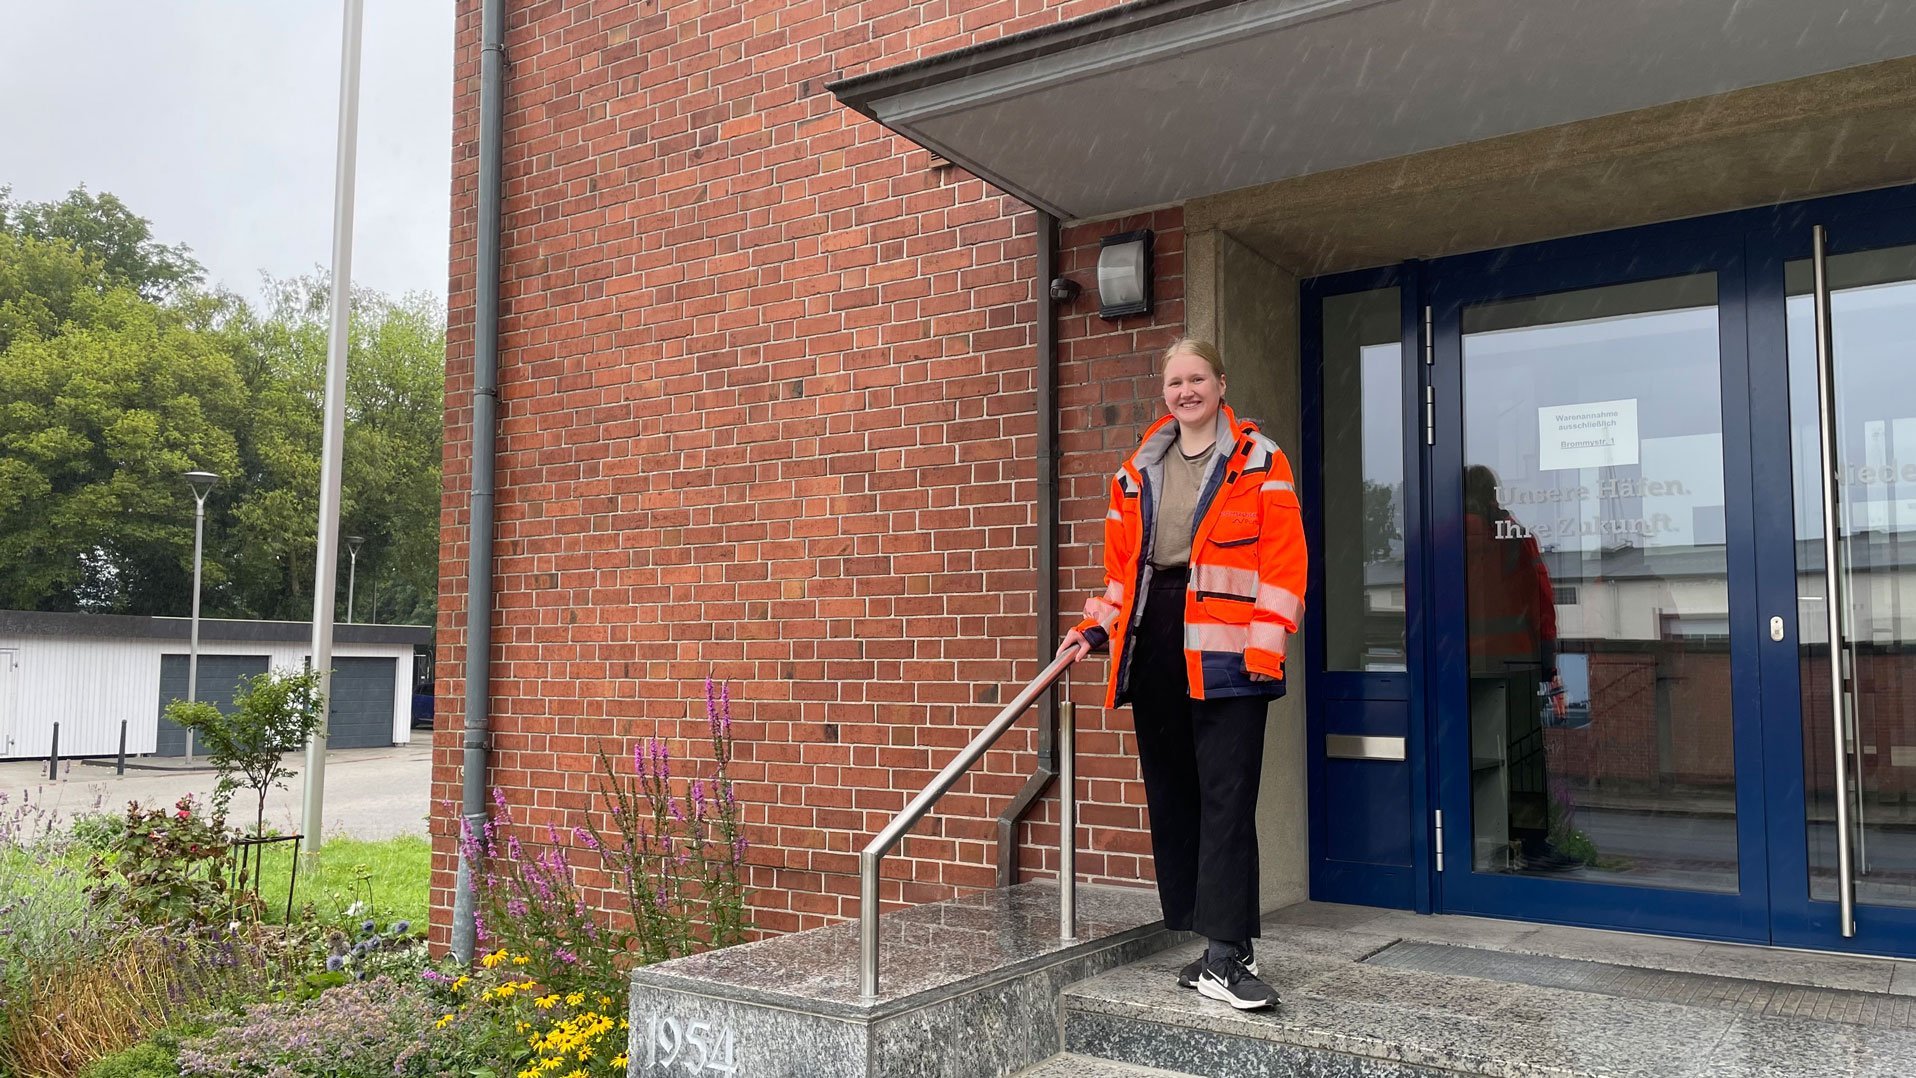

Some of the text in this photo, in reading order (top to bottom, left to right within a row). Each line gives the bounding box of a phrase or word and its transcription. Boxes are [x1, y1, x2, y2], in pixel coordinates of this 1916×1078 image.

[1555, 410, 1619, 422] Warenannahme
[1558, 419, 1617, 431] ausschließlich
[1610, 437, 1616, 446] 1
[1494, 476, 1692, 506] Unsere Häfen.
[1494, 512, 1679, 539] Ihre Zukunft.
[645, 1011, 740, 1078] 1954
